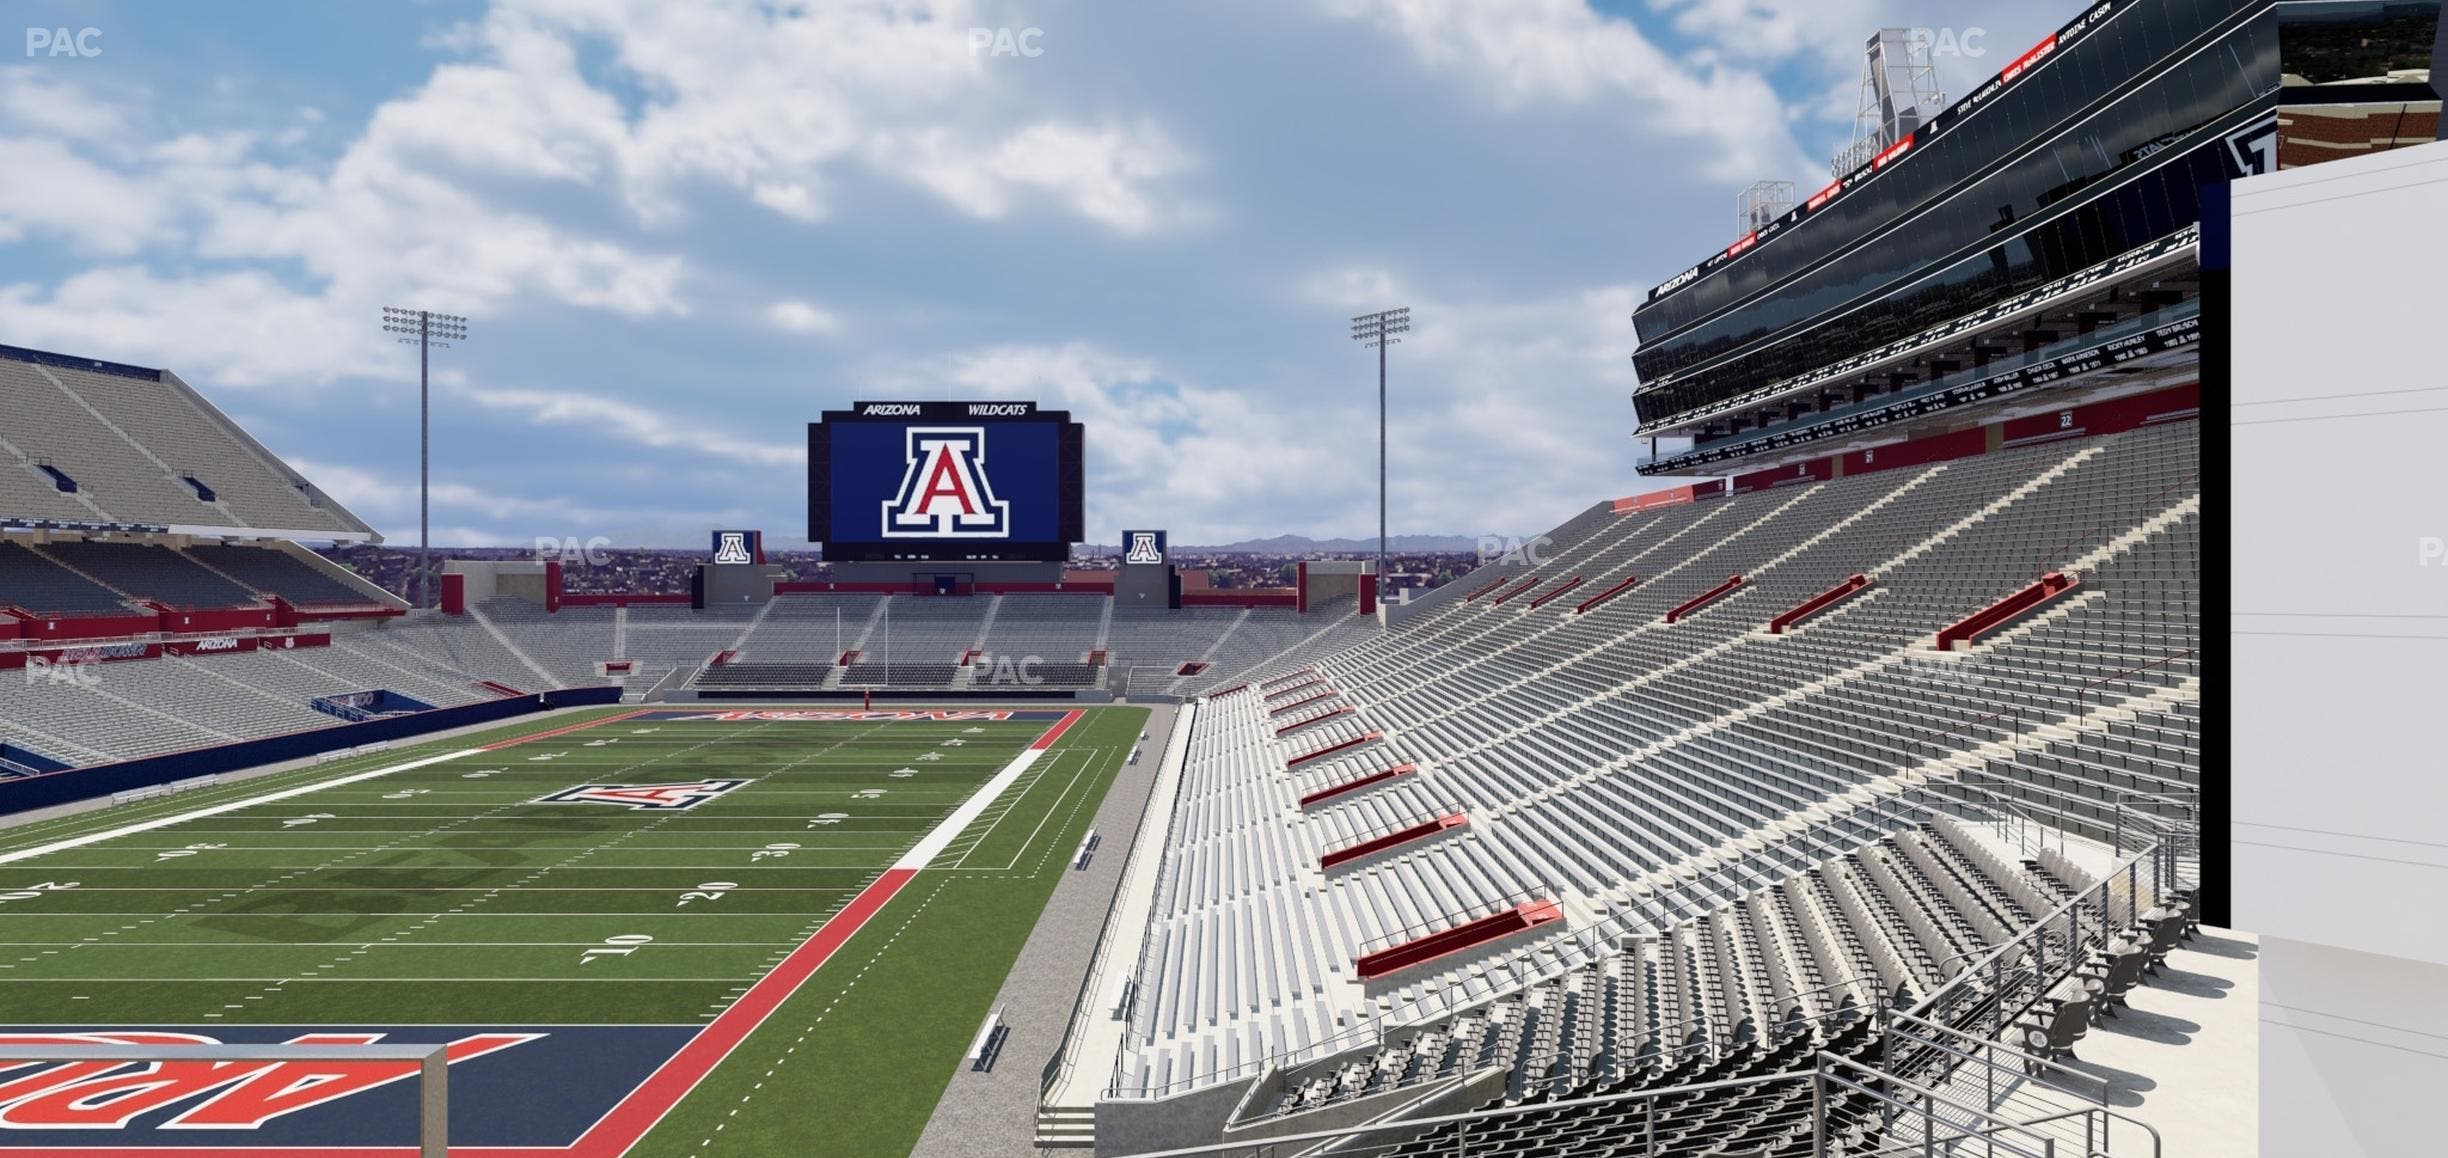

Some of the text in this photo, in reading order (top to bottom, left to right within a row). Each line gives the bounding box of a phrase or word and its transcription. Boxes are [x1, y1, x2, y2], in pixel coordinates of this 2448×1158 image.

[2058, 20, 2086, 45] ANTOINE
[2089, 1, 2112, 23] CASON
[1655, 267, 1698, 297] ARIZONA
[863, 404, 1029, 416] ARIZONA WILDCATS
[2061, 415, 2073, 427] 22
[882, 427, 1009, 538] A
[715, 533, 750, 565] A
[1126, 533, 1162, 565] A
[196, 638, 237, 651] ARIZONA
[528, 779, 756, 811] A
[752, 843, 802, 859] 30
[680, 882, 738, 901] 20
[581, 934, 654, 957] 10
